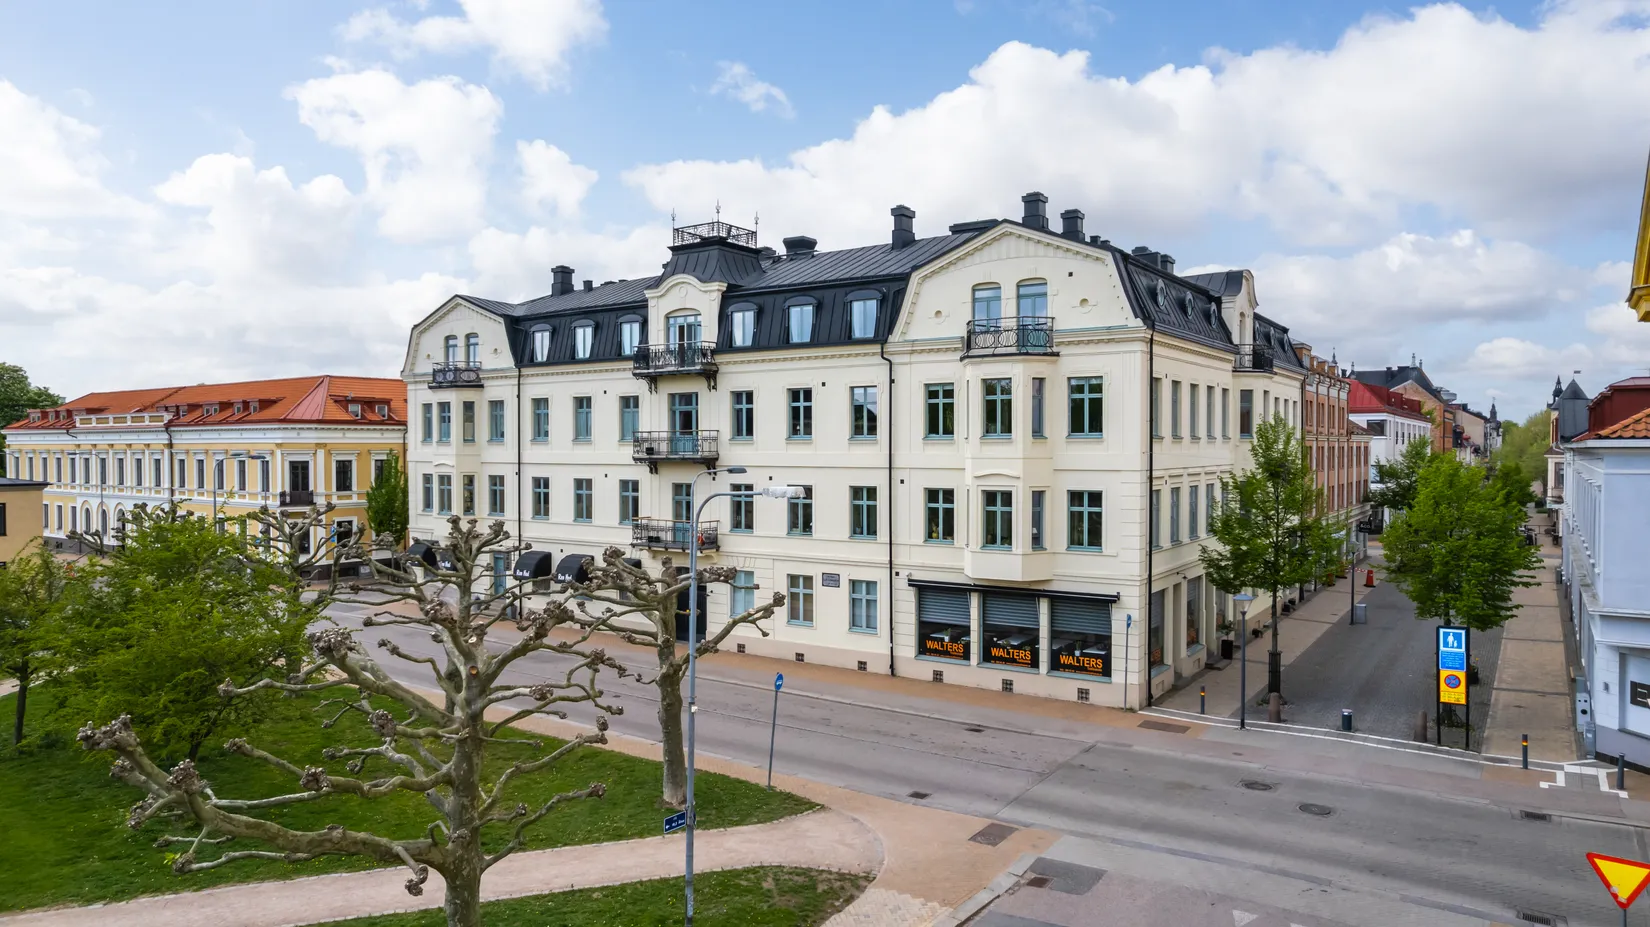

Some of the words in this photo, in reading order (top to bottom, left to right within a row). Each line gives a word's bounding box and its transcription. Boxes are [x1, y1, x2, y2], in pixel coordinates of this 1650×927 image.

[926, 639, 964, 653] WALTERS
[990, 647, 1031, 660] WALTERS
[1059, 654, 1103, 669] WALTERS
